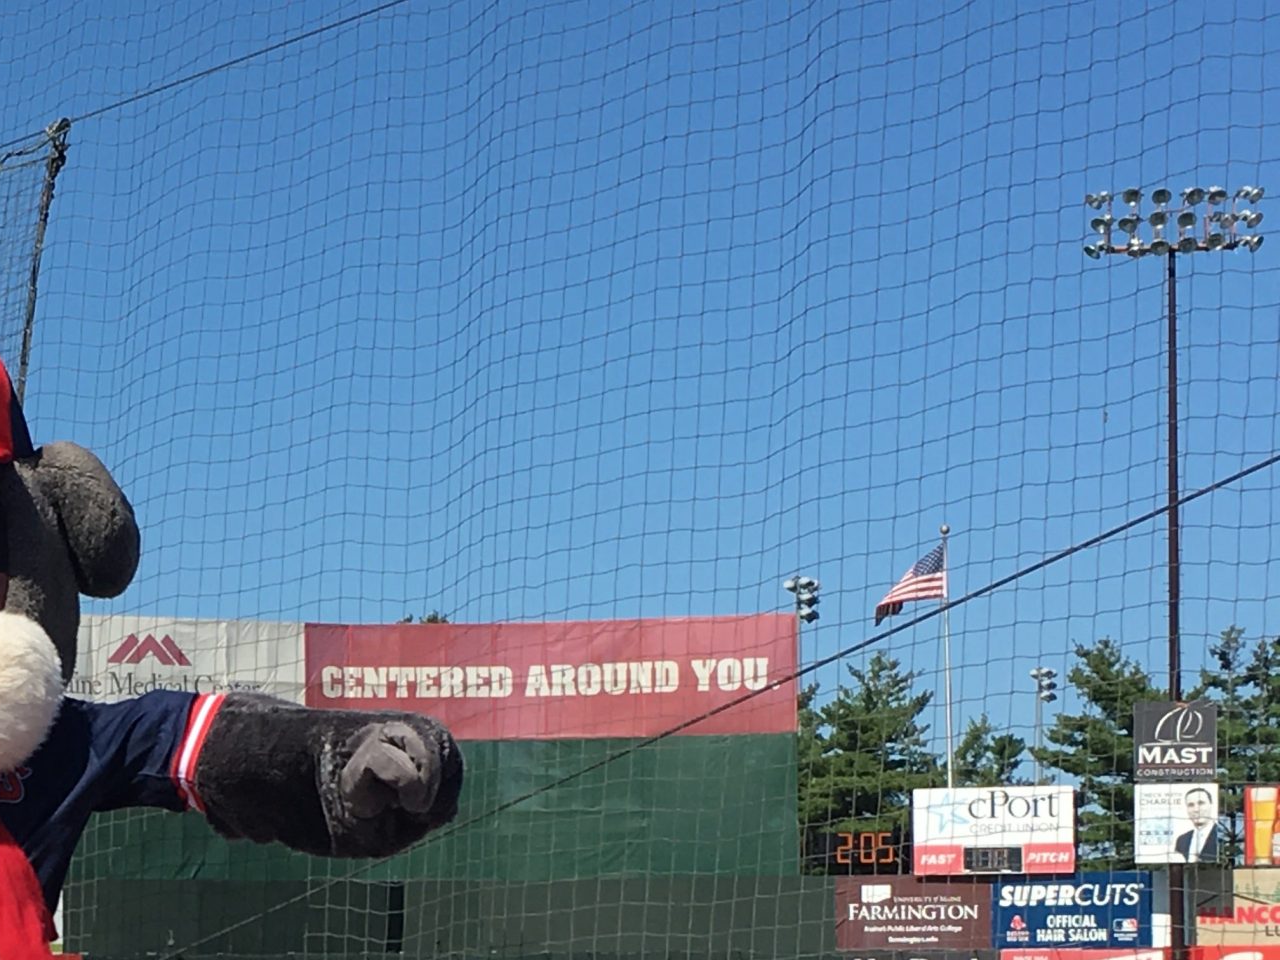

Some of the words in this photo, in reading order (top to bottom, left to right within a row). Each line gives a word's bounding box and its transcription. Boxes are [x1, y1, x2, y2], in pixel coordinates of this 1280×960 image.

[321, 665, 513, 699] CENTERED
[525, 660, 679, 697] AROUND
[1137, 746, 1213, 764] MAST
[1136, 768, 1214, 777] CONSTRUCTION
[968, 789, 1060, 819] cPort
[970, 821, 1012, 834] CREDIT
[1018, 821, 1059, 833] UNION
[836, 832, 895, 864] 2:05
[920, 853, 956, 865] FAST
[1026, 851, 1070, 864] PITCH
[998, 882, 1141, 907] SUPERCUTS
[848, 903, 979, 921] FARMINGTON
[1046, 914, 1098, 928] OFFICIAL
[1035, 928, 1067, 942] HAIR
[1068, 928, 1108, 942] SALON
